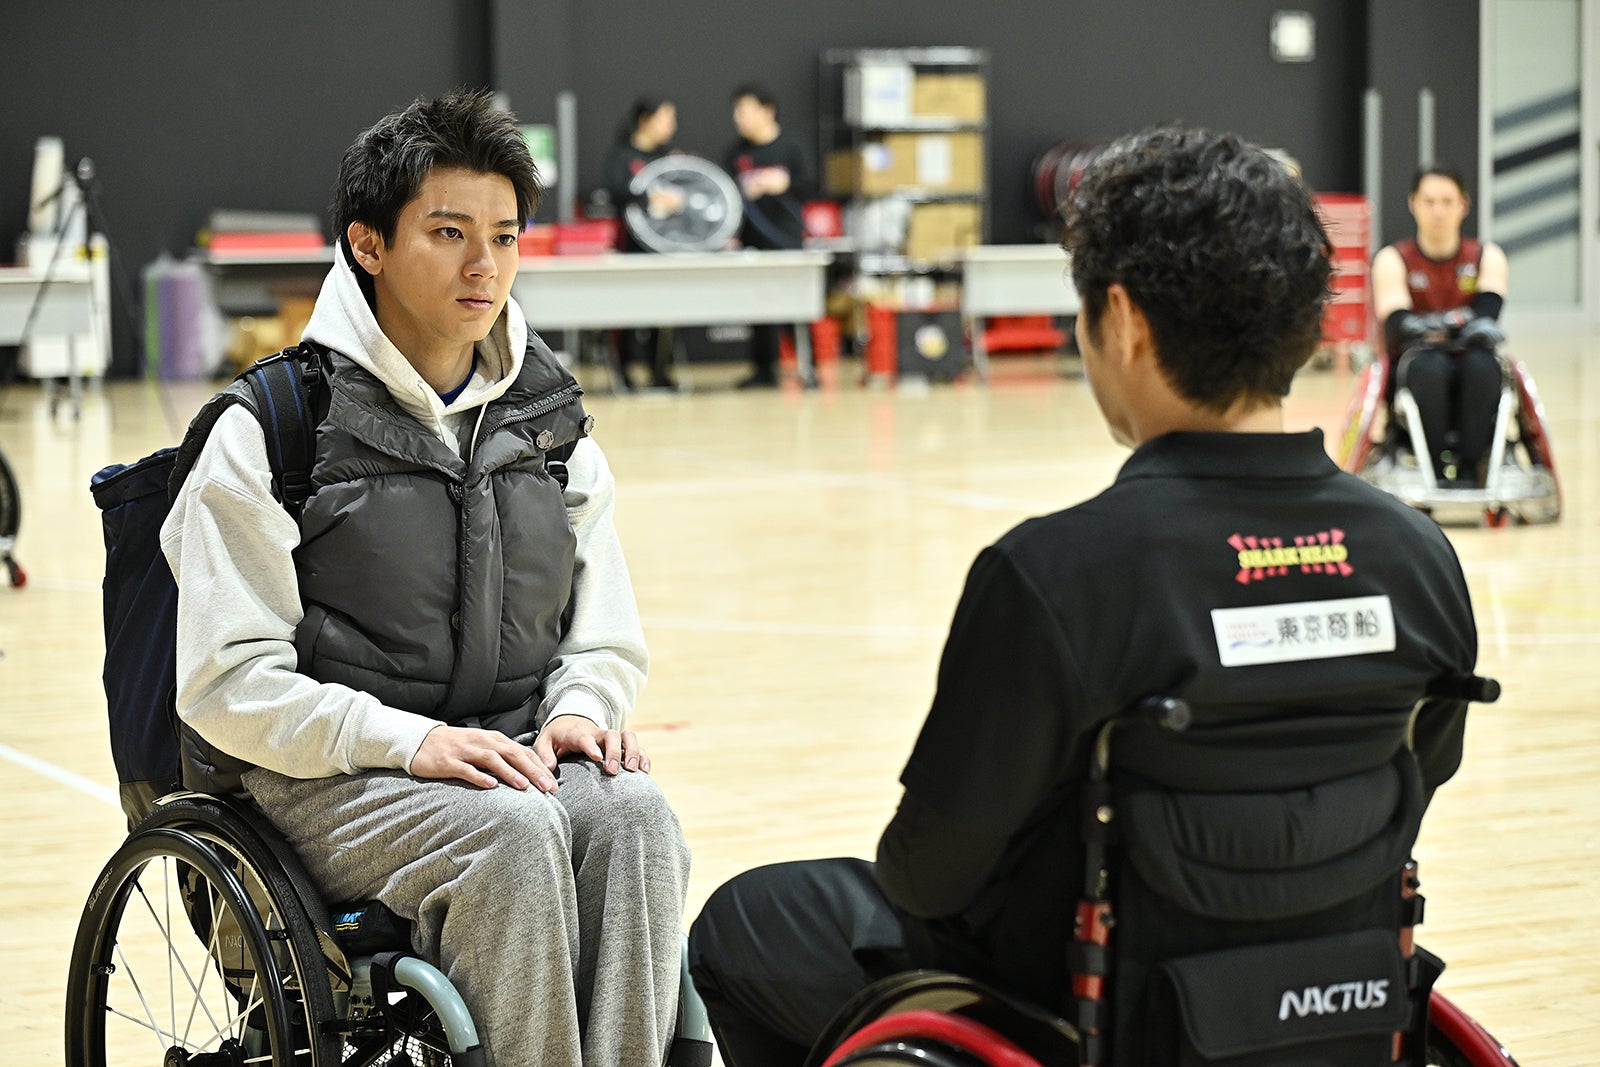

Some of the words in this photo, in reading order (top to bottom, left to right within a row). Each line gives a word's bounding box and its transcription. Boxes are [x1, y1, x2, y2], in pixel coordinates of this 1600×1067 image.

[1275, 609, 1380, 645] 東京商船
[1278, 979, 1389, 1020] NACTUS
